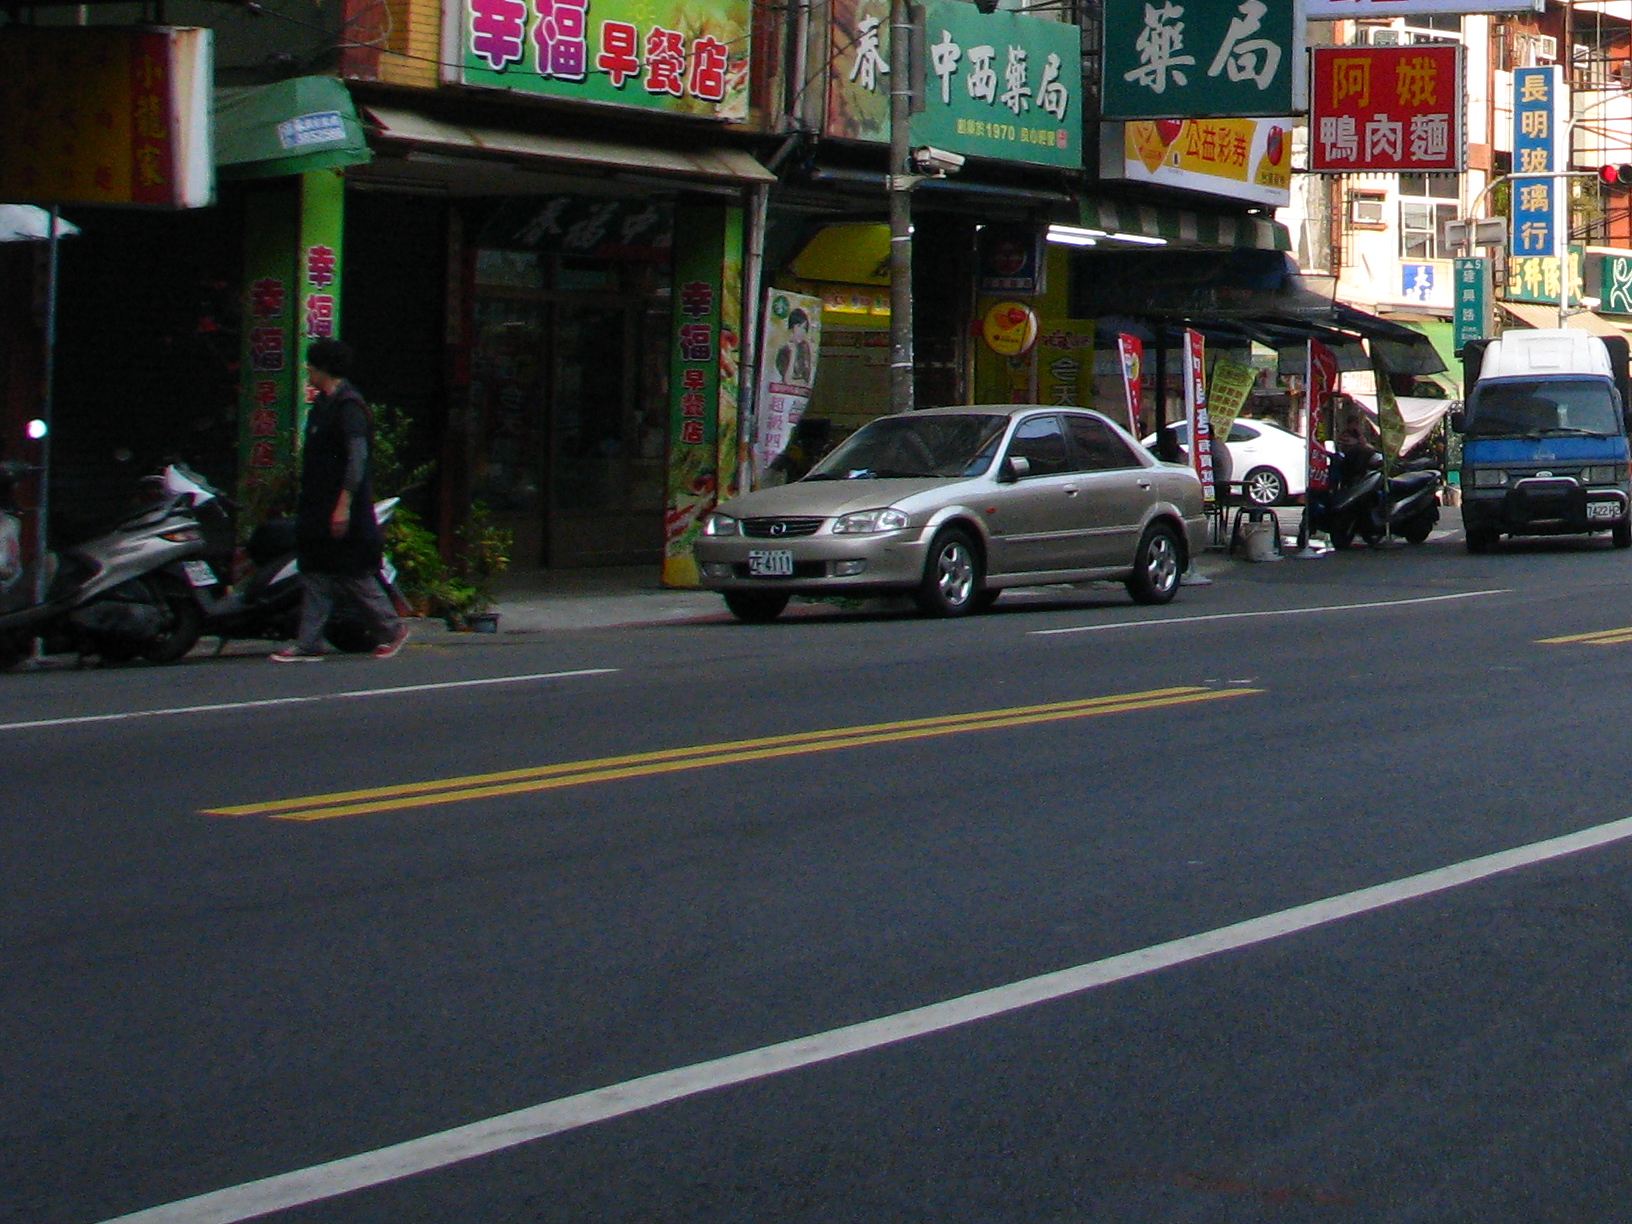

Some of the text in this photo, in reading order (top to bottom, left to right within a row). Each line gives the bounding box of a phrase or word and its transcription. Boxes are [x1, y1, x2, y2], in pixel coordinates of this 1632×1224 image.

[1331, 56, 1438, 109] 阿娥
[1186, 118, 1248, 168] 公益彩券
[1319, 113, 1449, 163] 鴨肉麵
[1519, 73, 1549, 251] 長明玻璃行
[250, 276, 286, 469] 幸福早餐店
[679, 280, 713, 445] 幸福早餐店
